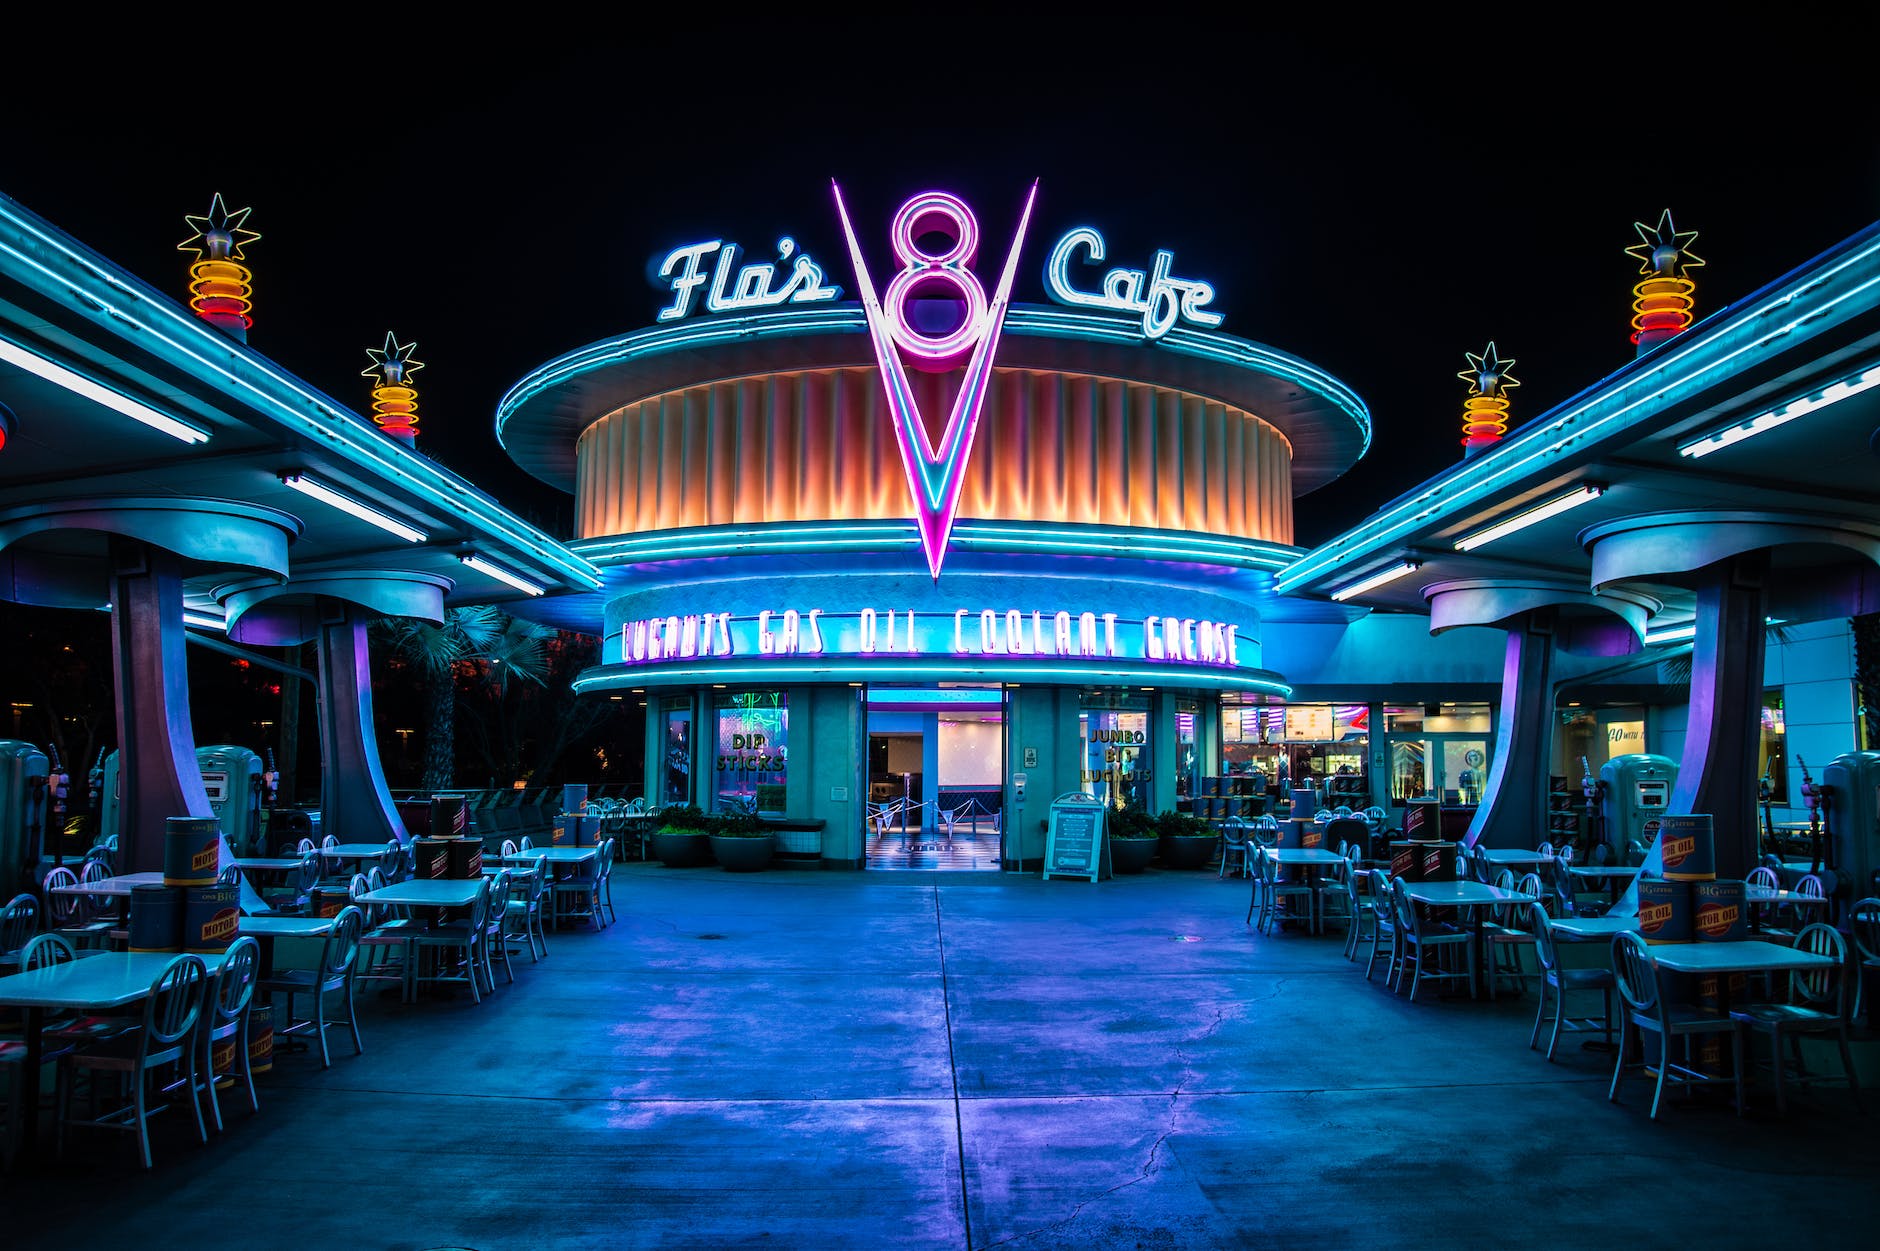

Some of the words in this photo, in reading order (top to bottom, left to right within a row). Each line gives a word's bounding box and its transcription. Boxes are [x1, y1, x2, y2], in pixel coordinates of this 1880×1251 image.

[657, 237, 842, 322] Flo's
[1047, 228, 1224, 340] Cafe
[758, 609, 822, 654] GAS
[859, 608, 918, 654] OIL
[954, 608, 1118, 657] COOLANT
[1142, 615, 1240, 666] GREASE
[732, 734, 765, 749] DIP
[1090, 730, 1145, 743] JUMBO
[717, 755, 785, 771] STICKS
[1080, 769, 1152, 782] LUGNUTS
[1678, 840, 1693, 851] OIL
[1655, 906, 1671, 917] OIL
[1722, 908, 1737, 920] OIL
[204, 917, 234, 936] MOTOR
